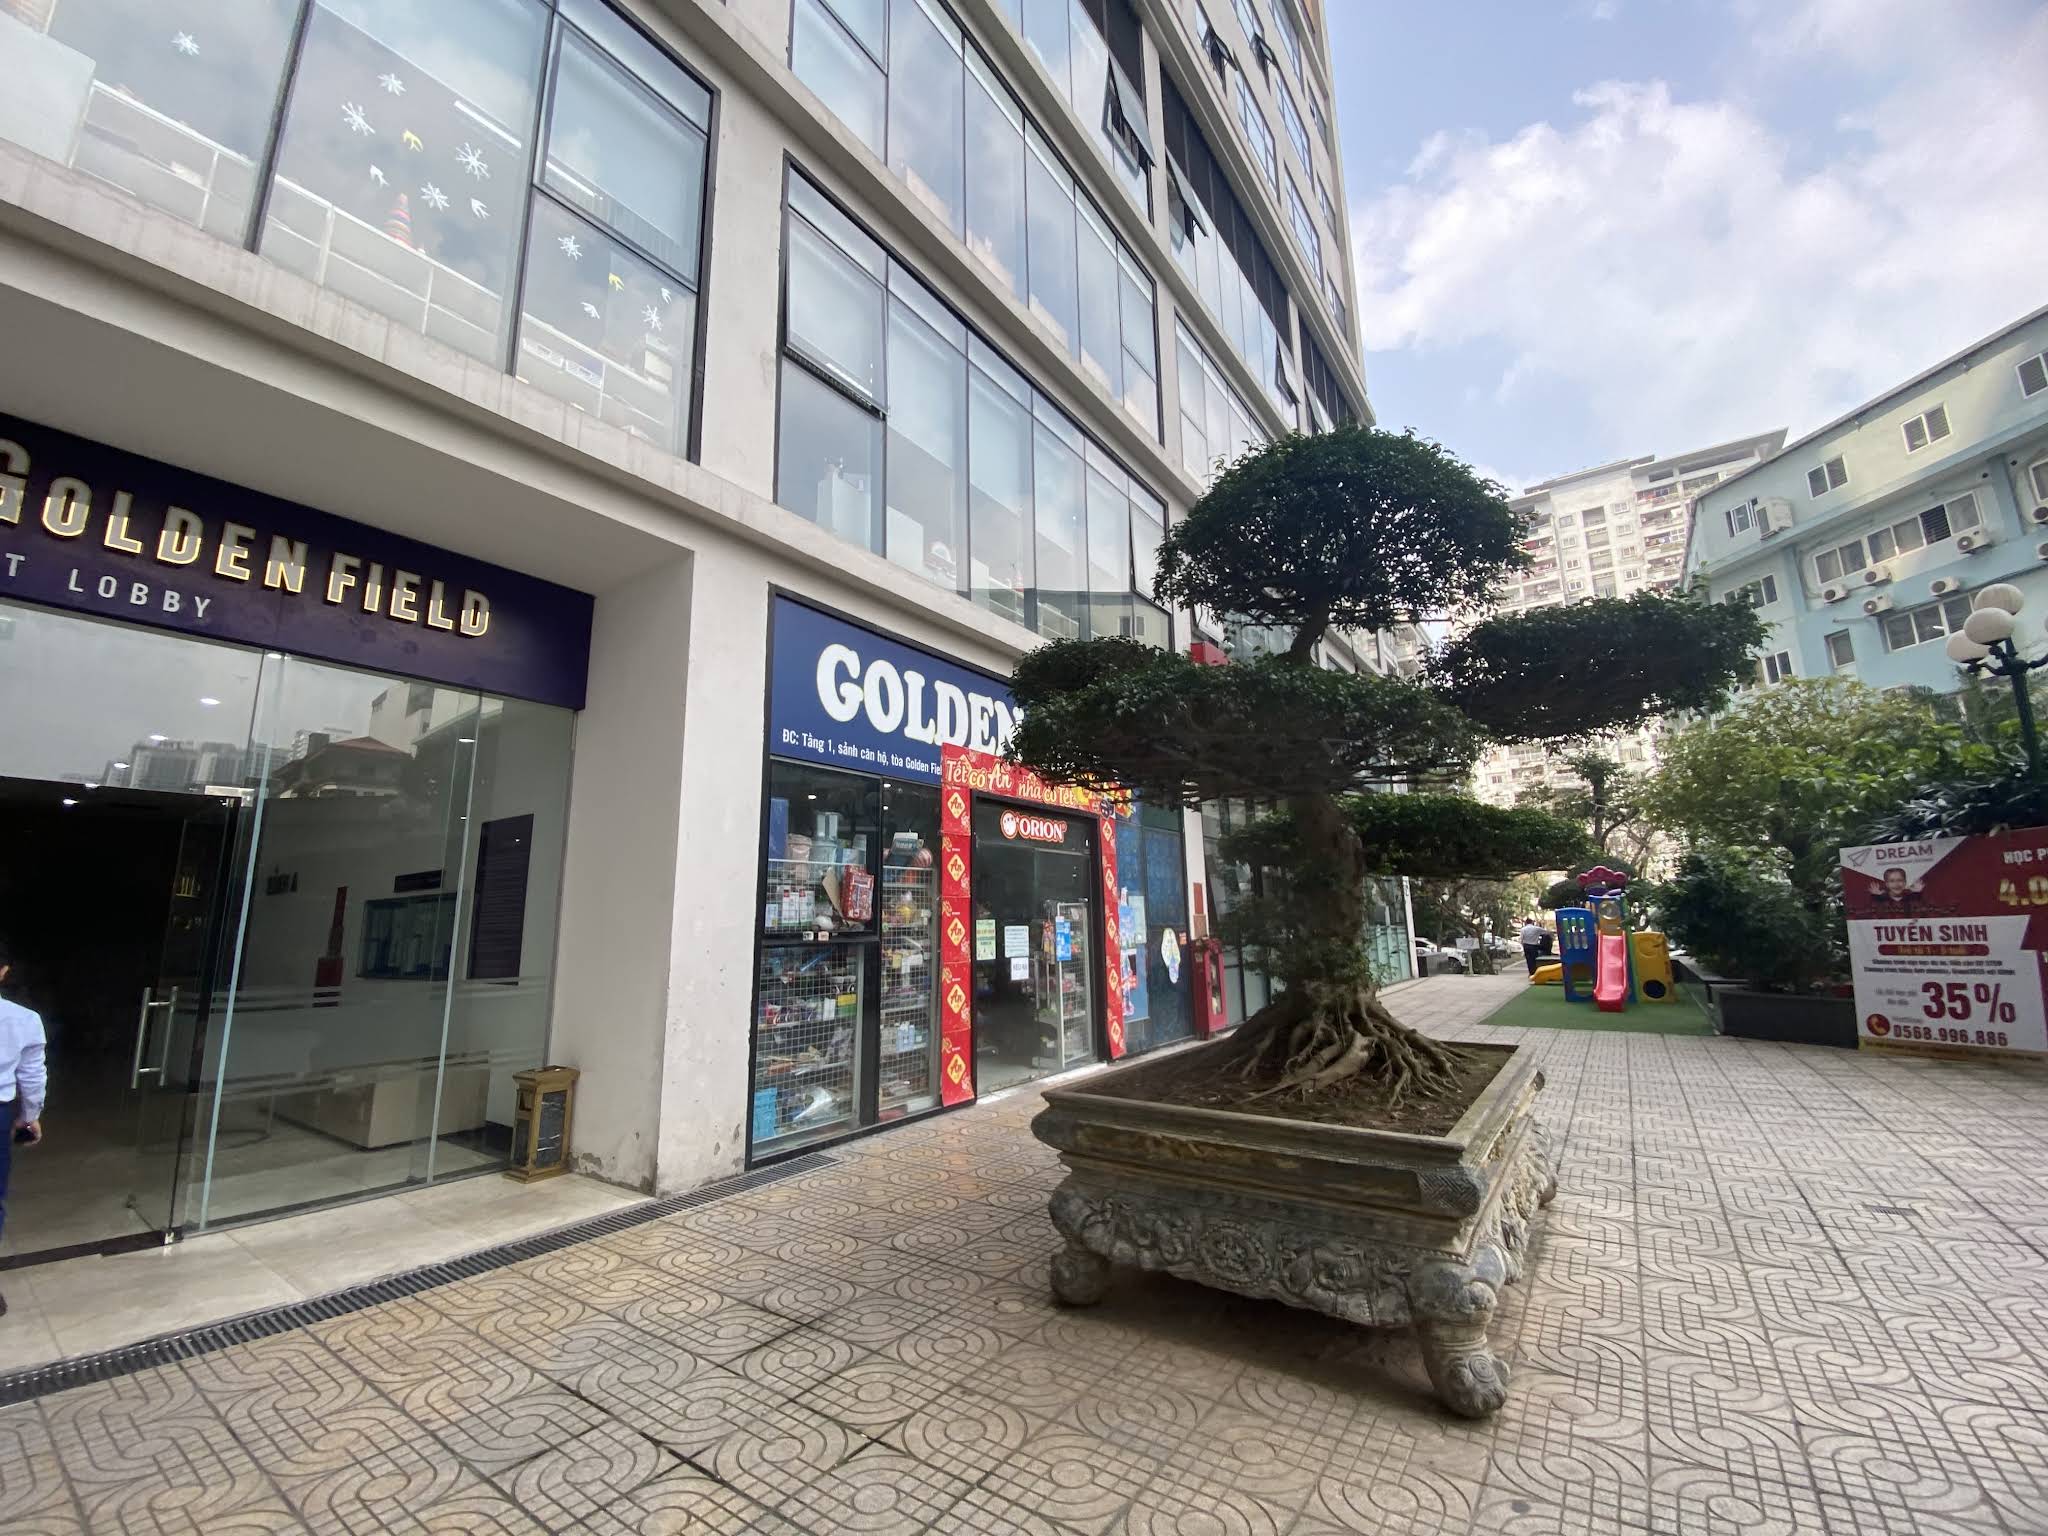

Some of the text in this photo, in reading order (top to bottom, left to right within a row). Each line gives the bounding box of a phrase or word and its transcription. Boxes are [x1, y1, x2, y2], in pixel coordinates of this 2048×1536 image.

[0, 438, 491, 638] GOLDEN FIELD
[67, 568, 212, 619] LOBBY
[816, 643, 1025, 758] GOLDEN
[782, 728, 800, 746] ĐC:
[801, 731, 825, 753] Tầng
[837, 740, 859, 758] sảnh
[890, 753, 904, 768] tòa
[905, 756, 929, 773] Golden
[930, 762, 943, 776] Fiel
[945, 759, 968, 784] Tết
[968, 769, 987, 789] có
[1018, 818, 1064, 841] ORION
[1875, 844, 1933, 860] DREAM
[2036, 847, 2048, 861] P
[1873, 918, 1988, 942] TUYỂN SINH
[1921, 981, 2017, 1024] 35%
